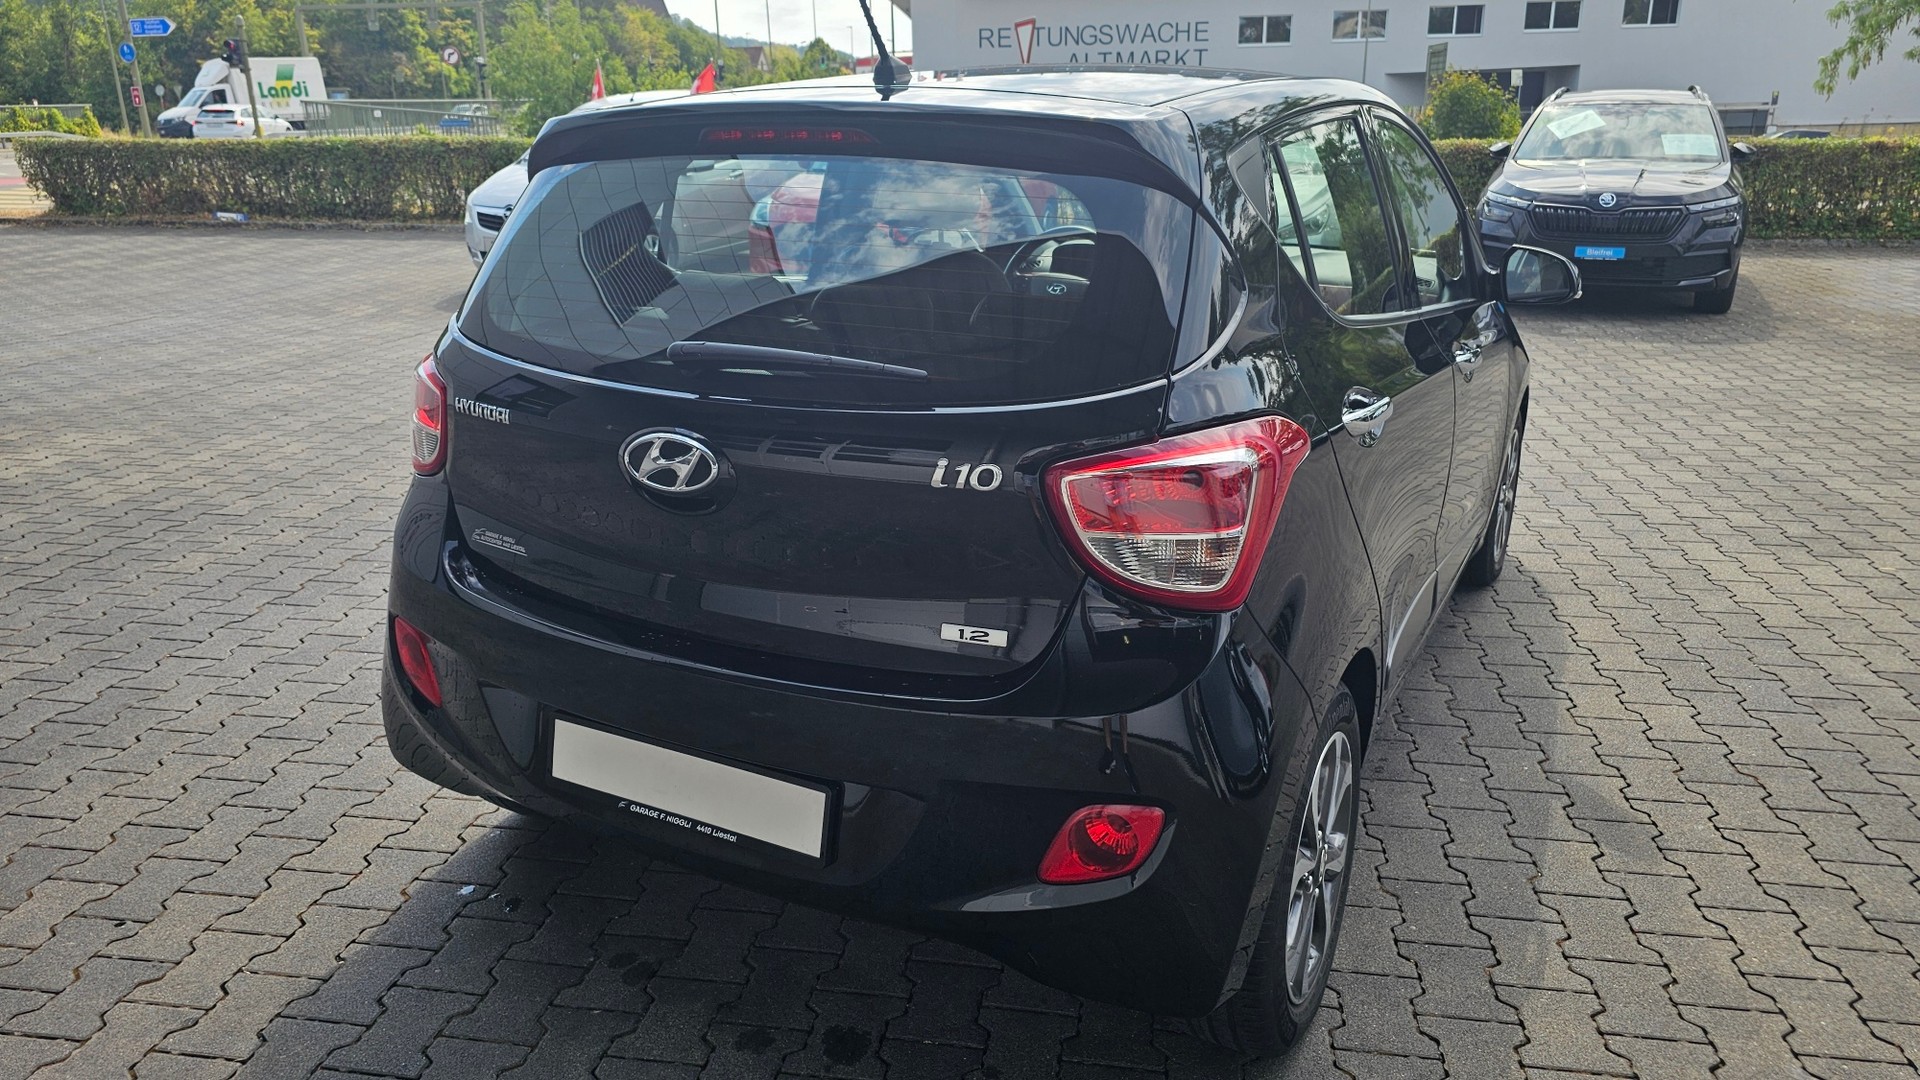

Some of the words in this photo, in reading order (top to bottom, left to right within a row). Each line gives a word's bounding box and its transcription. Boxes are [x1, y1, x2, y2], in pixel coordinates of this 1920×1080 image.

[257, 81, 309, 98] Landi
[455, 397, 510, 425] HYUNDAI
[931, 457, 1003, 491] i10
[958, 629, 990, 643] 1.2
[630, 804, 659, 819] GARAGE
[659, 813, 666, 821] F.
[666, 815, 692, 829] NIGGLI
[696, 824, 712, 835] 4410
[712, 828, 738, 843] Liestal
